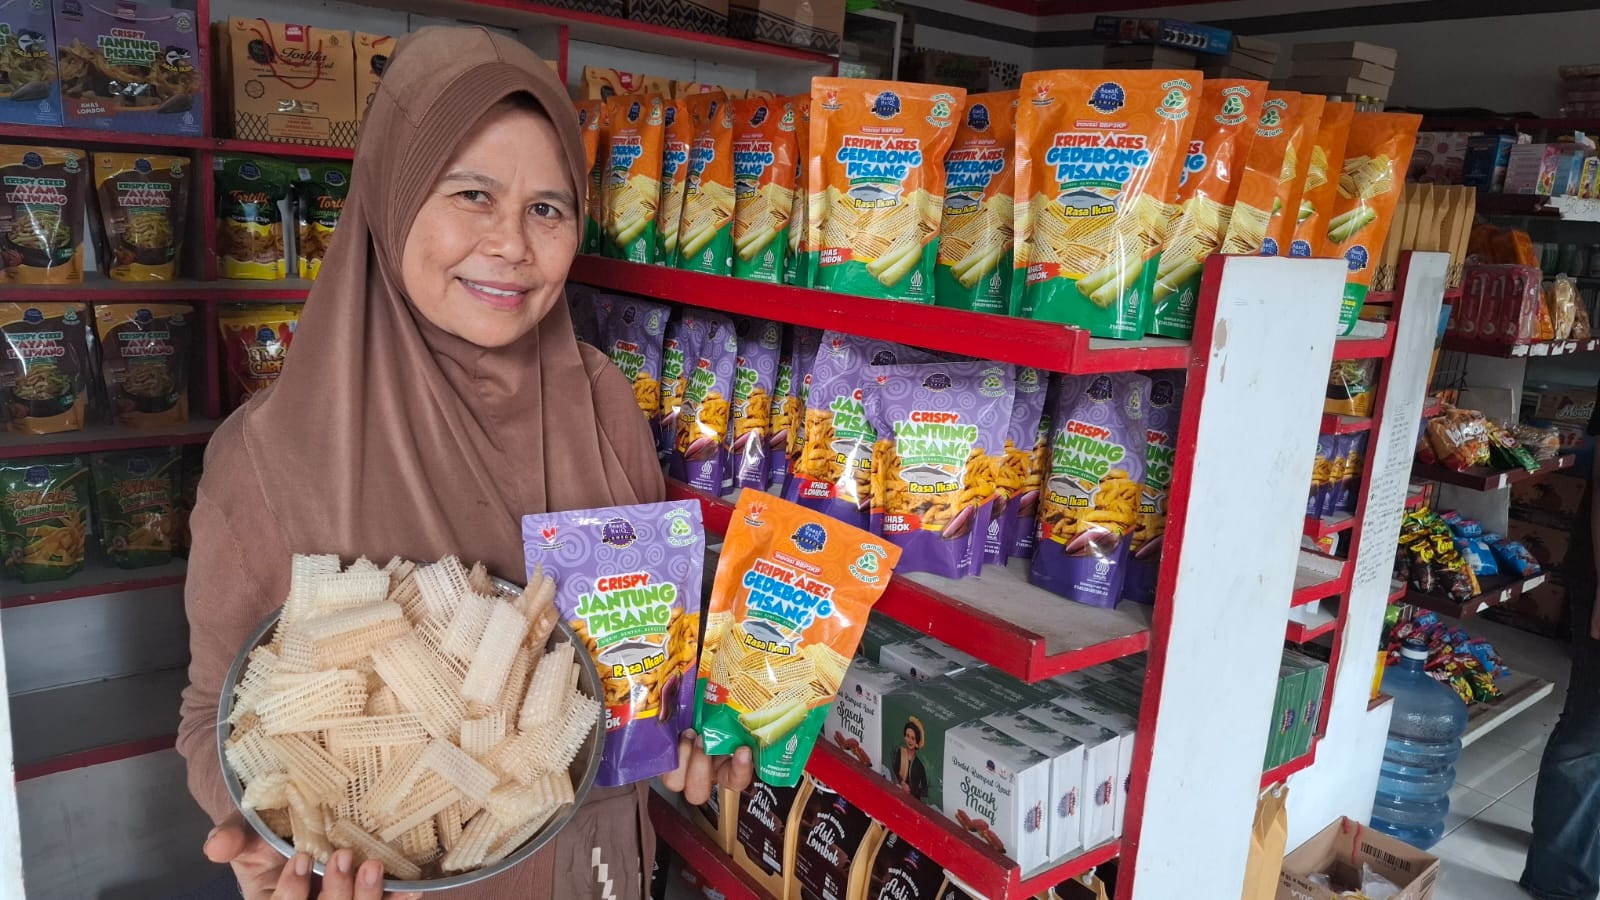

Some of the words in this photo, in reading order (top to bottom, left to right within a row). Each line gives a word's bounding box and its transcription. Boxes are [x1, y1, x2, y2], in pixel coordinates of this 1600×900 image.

[112, 29, 145, 39] CRISPY
[99, 37, 159, 51] JANTUNG
[105, 49, 155, 60] PISANG
[844, 136, 883, 149] KRIPIK
[885, 139, 917, 151] ARES
[1056, 135, 1100, 147] KRIPIK
[1103, 136, 1144, 149] ARES
[837, 147, 921, 165] GEDEBONG
[1047, 147, 1150, 166] GEDEBONG
[847, 161, 907, 179] PISANG
[1057, 163, 1130, 182] PISANG
[5, 177, 36, 185] KRISPY
[118, 182, 146, 190] KRISPY
[946, 173, 991, 187] PISANG
[6, 194, 67, 204] TALIWANG
[15, 186, 58, 195] AYAM
[127, 190, 166, 198] AYAM
[1065, 205, 1090, 216] Rasa
[1091, 204, 1115, 216] Ikan
[16, 340, 57, 348] AYAM
[911, 411, 959, 424] CRISPY
[1066, 420, 1111, 440] CRISPY
[897, 438, 970, 458] PISANG
[811, 481, 828, 490] KHAS
[909, 482, 935, 493] Rasa
[935, 482, 960, 493] Ikan
[1069, 495, 1089, 507] Ikan
[597, 573, 649, 592] CRISPY
[754, 560, 794, 583] KRIPIK
[794, 576, 832, 598] ARES
[576, 583, 676, 616] JANTUNG
[743, 570, 832, 616] GEDEBONG
[748, 589, 812, 626] PISANG
[589, 604, 670, 636] PISANG
[744, 634, 767, 651] Rasa
[767, 641, 790, 655] Ikan
[642, 652, 665, 672] Ikan
[752, 790, 771, 813] Asli
[960, 775, 998, 812] Sasak
[747, 799, 777, 832] Lombok
[813, 821, 836, 845] Asli
[806, 830, 840, 867] Lombok
